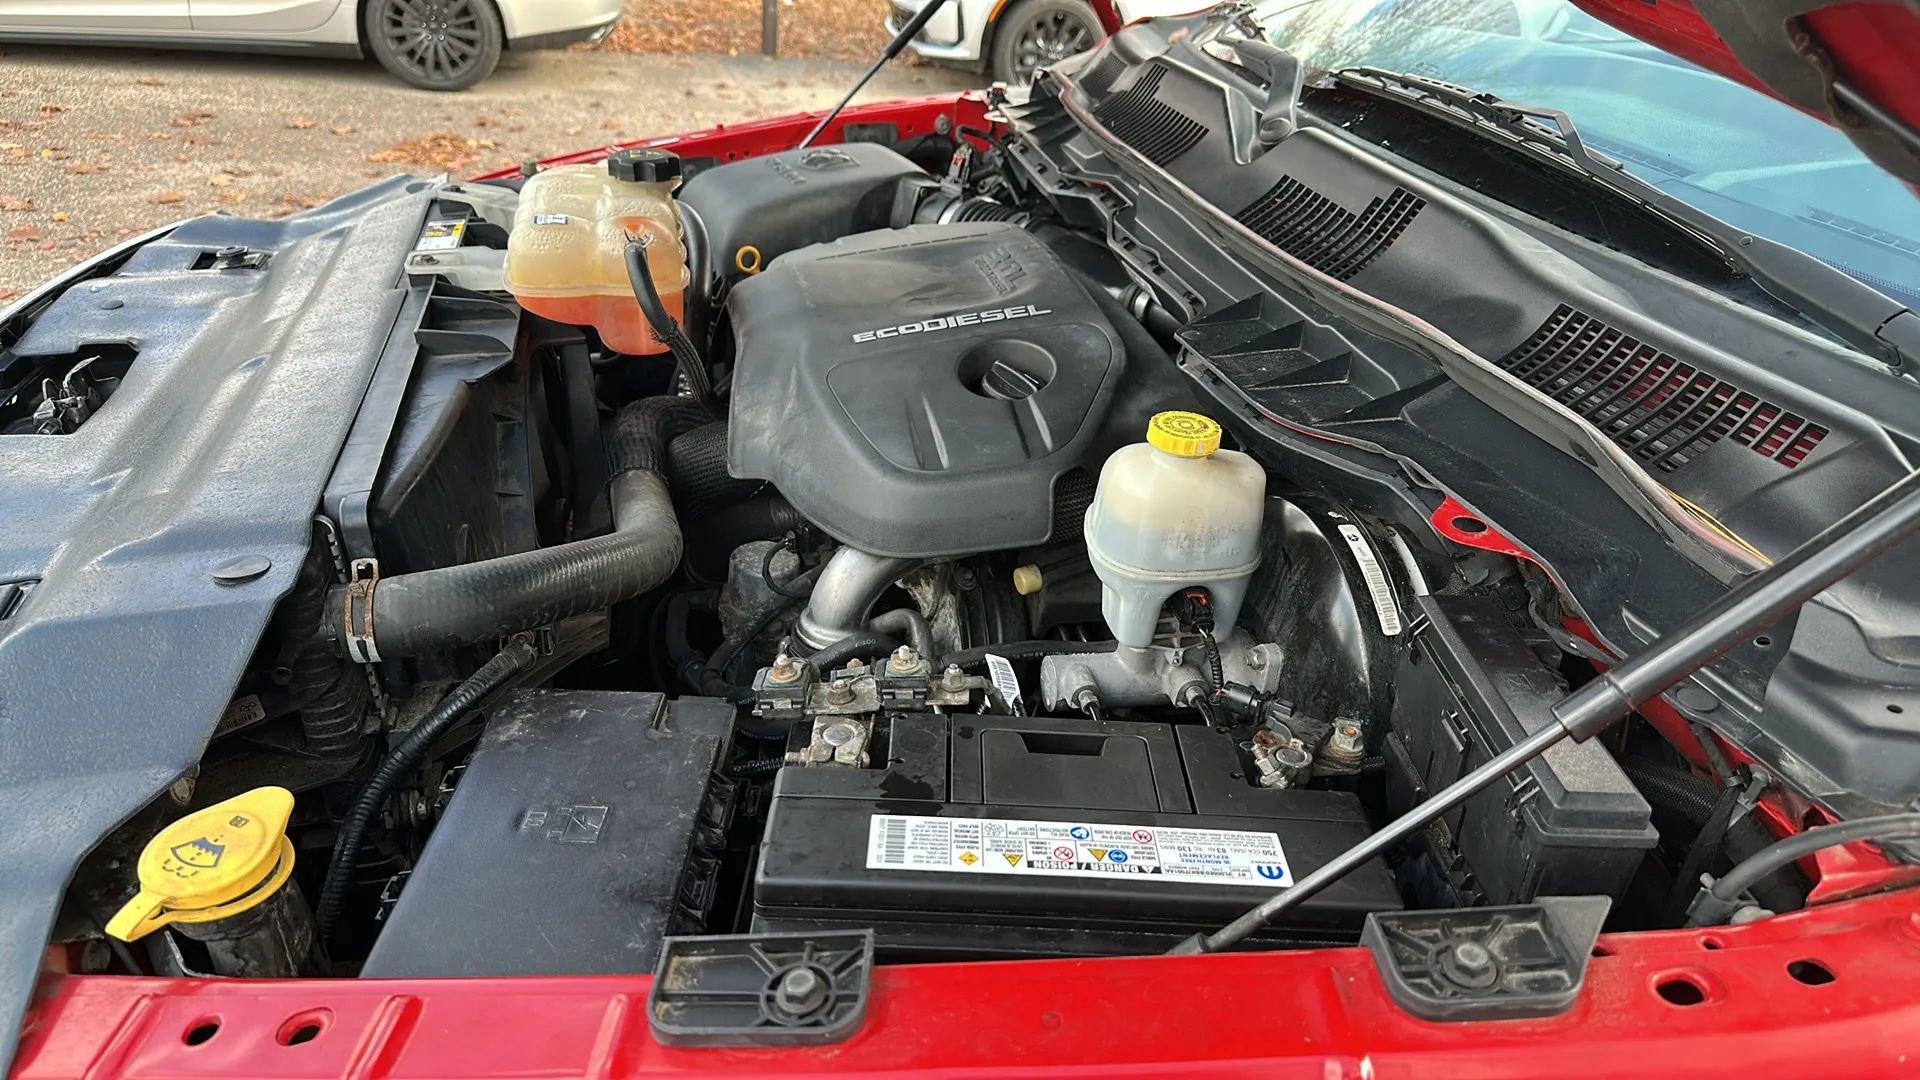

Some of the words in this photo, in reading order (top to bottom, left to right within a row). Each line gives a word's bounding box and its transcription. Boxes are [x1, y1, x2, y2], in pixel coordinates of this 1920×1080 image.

[852, 304, 1051, 343] ECODIESEL
[1033, 860, 1078, 870] POISON
[1090, 863, 1139, 873] DANGER
